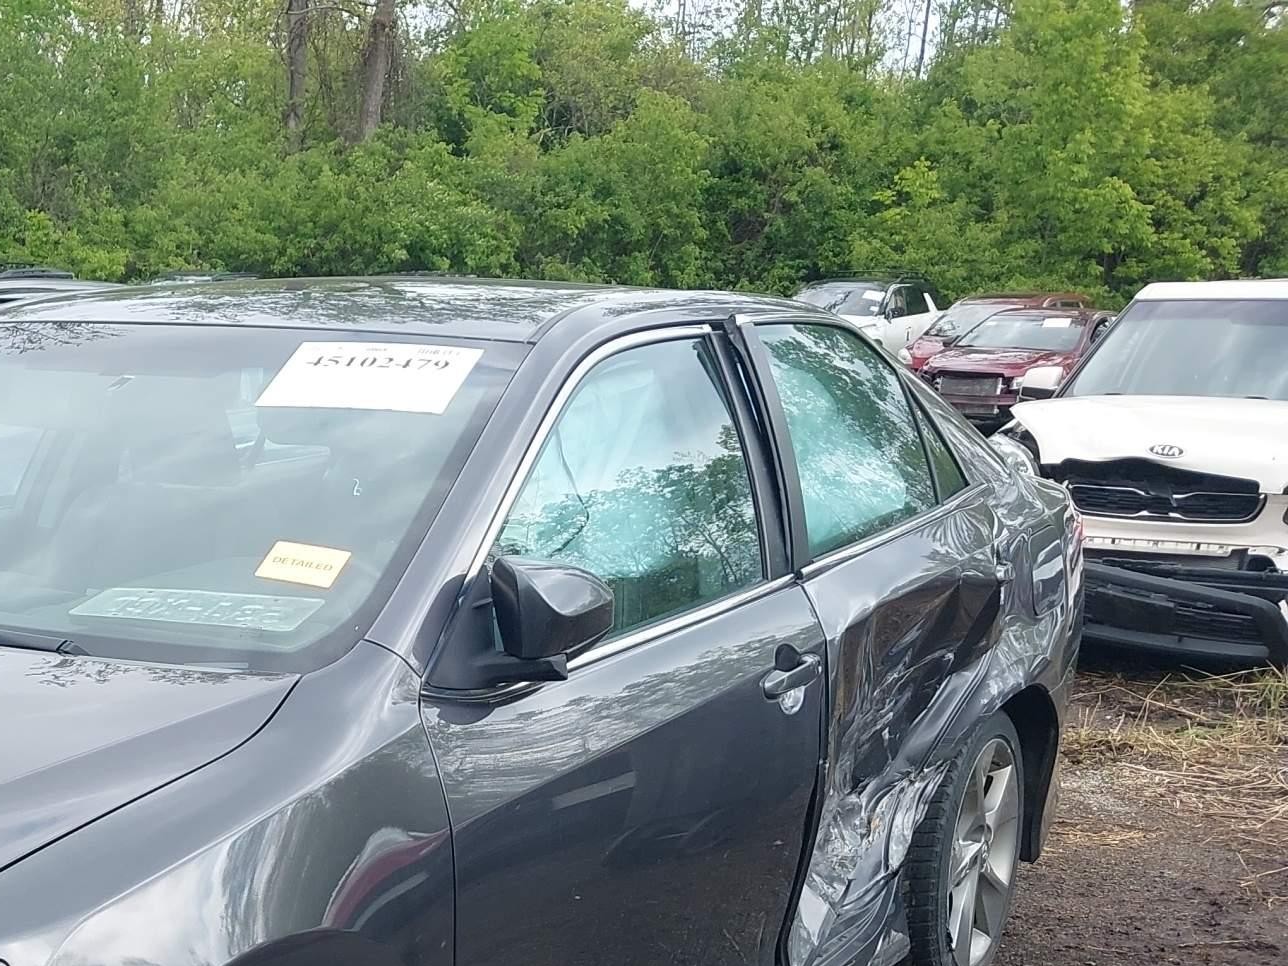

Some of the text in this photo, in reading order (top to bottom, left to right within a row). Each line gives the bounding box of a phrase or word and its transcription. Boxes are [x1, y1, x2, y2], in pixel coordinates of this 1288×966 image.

[306, 355, 450, 370] 45102479
[1152, 445, 1180, 457] KIA
[272, 555, 333, 572] DETAILED
